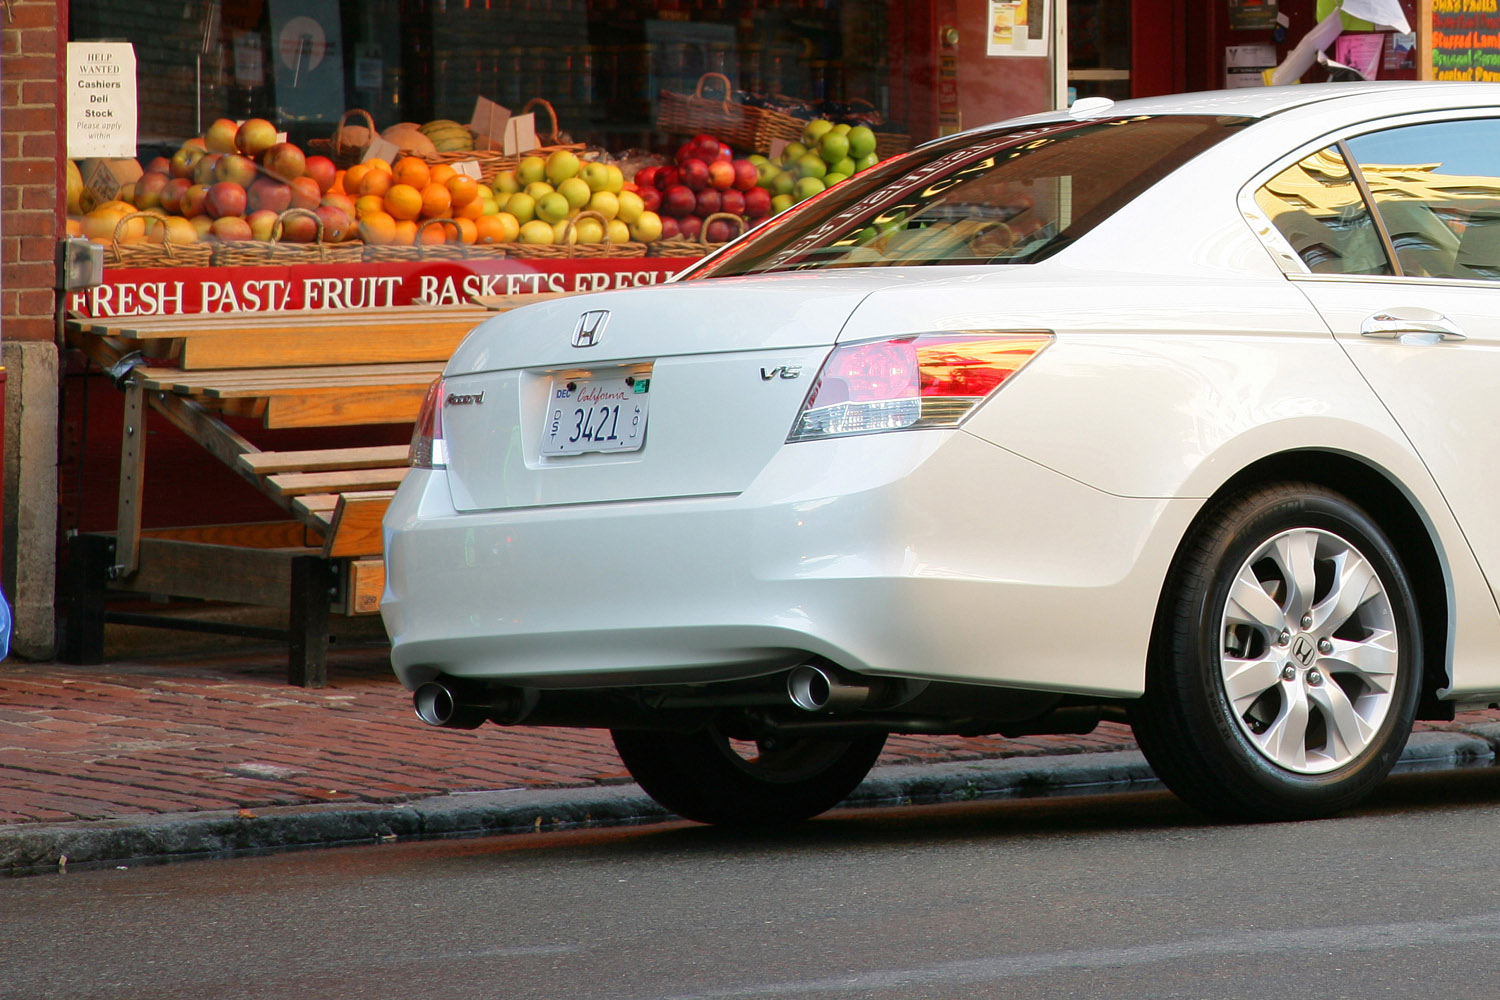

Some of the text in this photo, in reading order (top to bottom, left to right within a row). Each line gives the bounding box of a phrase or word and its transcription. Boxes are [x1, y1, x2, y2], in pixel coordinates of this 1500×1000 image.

[87, 53, 112, 61] HELP
[80, 65, 120, 73] WANTED
[78, 80, 121, 88] Cashiers
[90, 94, 108, 103] Deli
[85, 109, 113, 118] Stock
[77, 121, 122, 130] Please apply
[303, 277, 402, 310] FRUIT
[758, 364, 802, 382] V6
[557, 389, 571, 399] DEC
[577, 387, 629, 405] California
[569, 405, 620, 443] 3421
